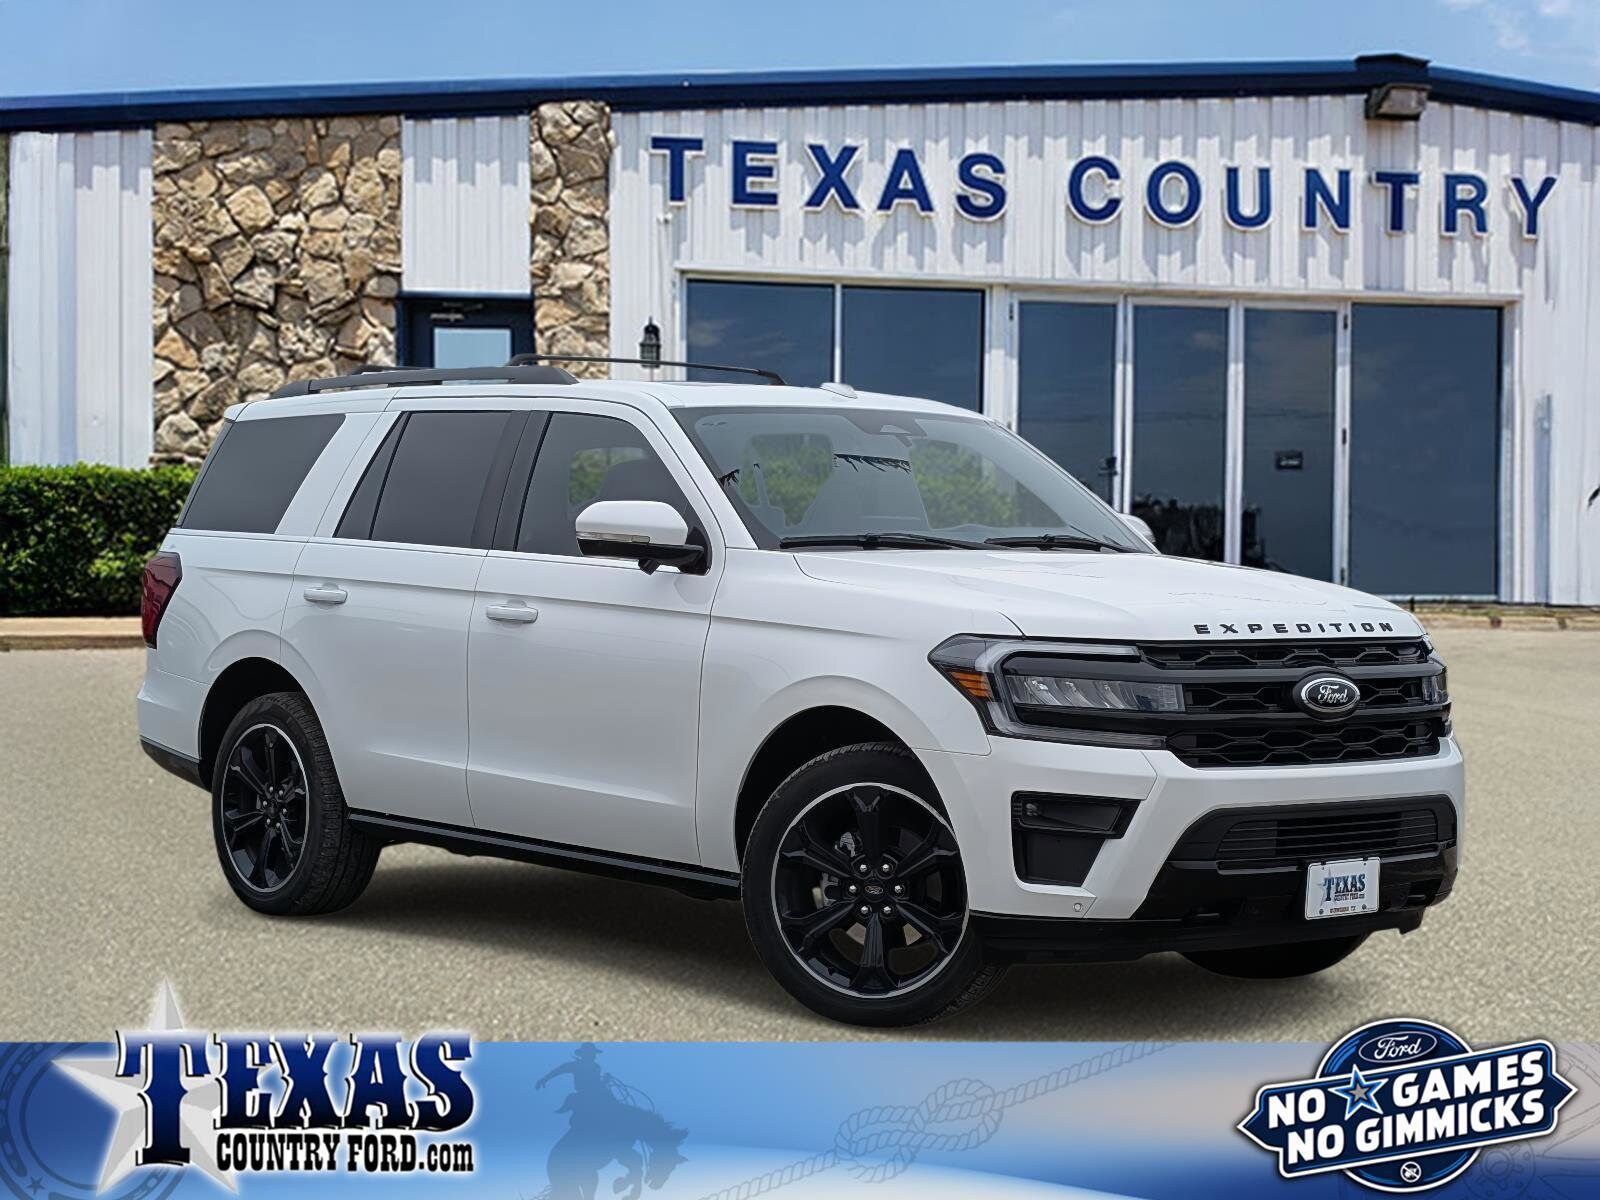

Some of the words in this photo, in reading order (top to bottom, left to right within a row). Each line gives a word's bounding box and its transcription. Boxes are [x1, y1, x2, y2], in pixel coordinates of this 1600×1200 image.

[650, 135, 1007, 221] TEXAS
[1067, 154, 1557, 240] COUNTRY
[1193, 621, 1394, 635] EXPEDITION
[1317, 683, 1349, 705] Ford
[1322, 873, 1366, 902] TEXAS
